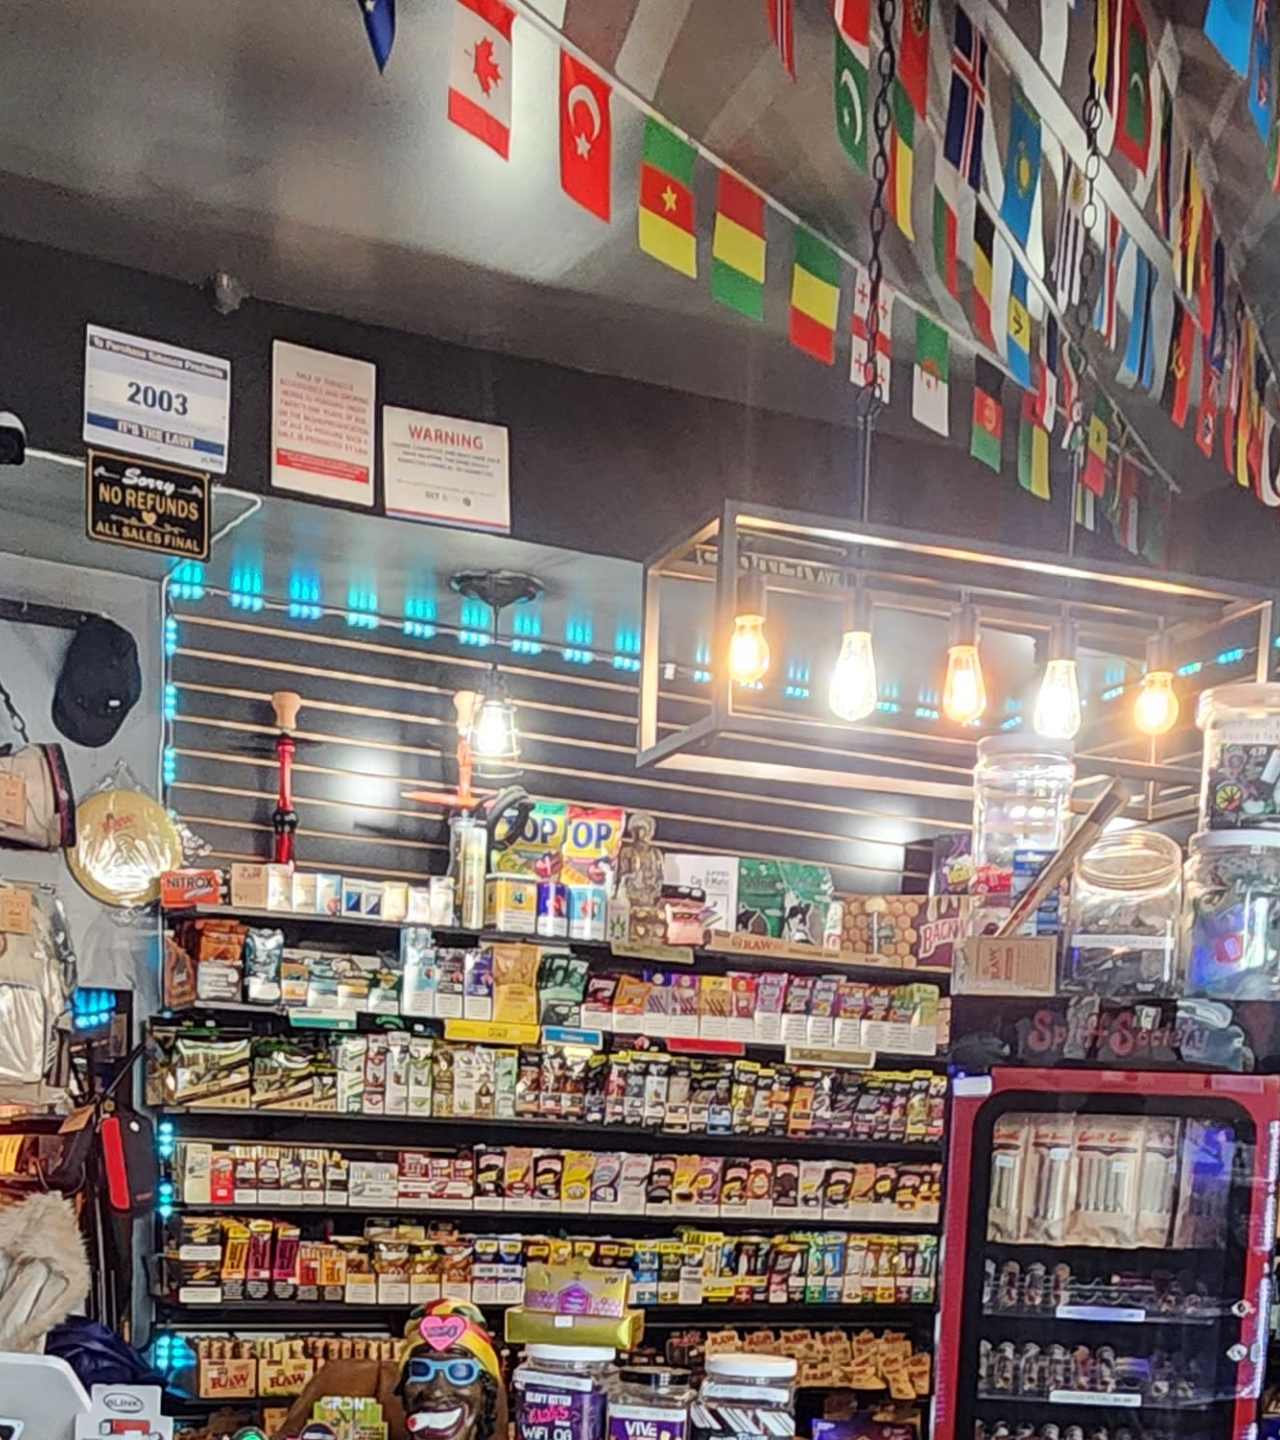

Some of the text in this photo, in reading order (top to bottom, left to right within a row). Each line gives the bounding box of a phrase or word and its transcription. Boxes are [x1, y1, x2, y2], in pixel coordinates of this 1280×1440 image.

[127, 380, 189, 417] 2003
[408, 423, 484, 451] WARNING
[121, 467, 177, 496] Sorry
[98, 482, 200, 522] NO REFUNDS
[96, 520, 201, 552] ALL SALES FINAL
[166, 876, 215, 890] NITROX
[211, 1373, 250, 1390] RAW
[270, 1372, 305, 1388] RAW
